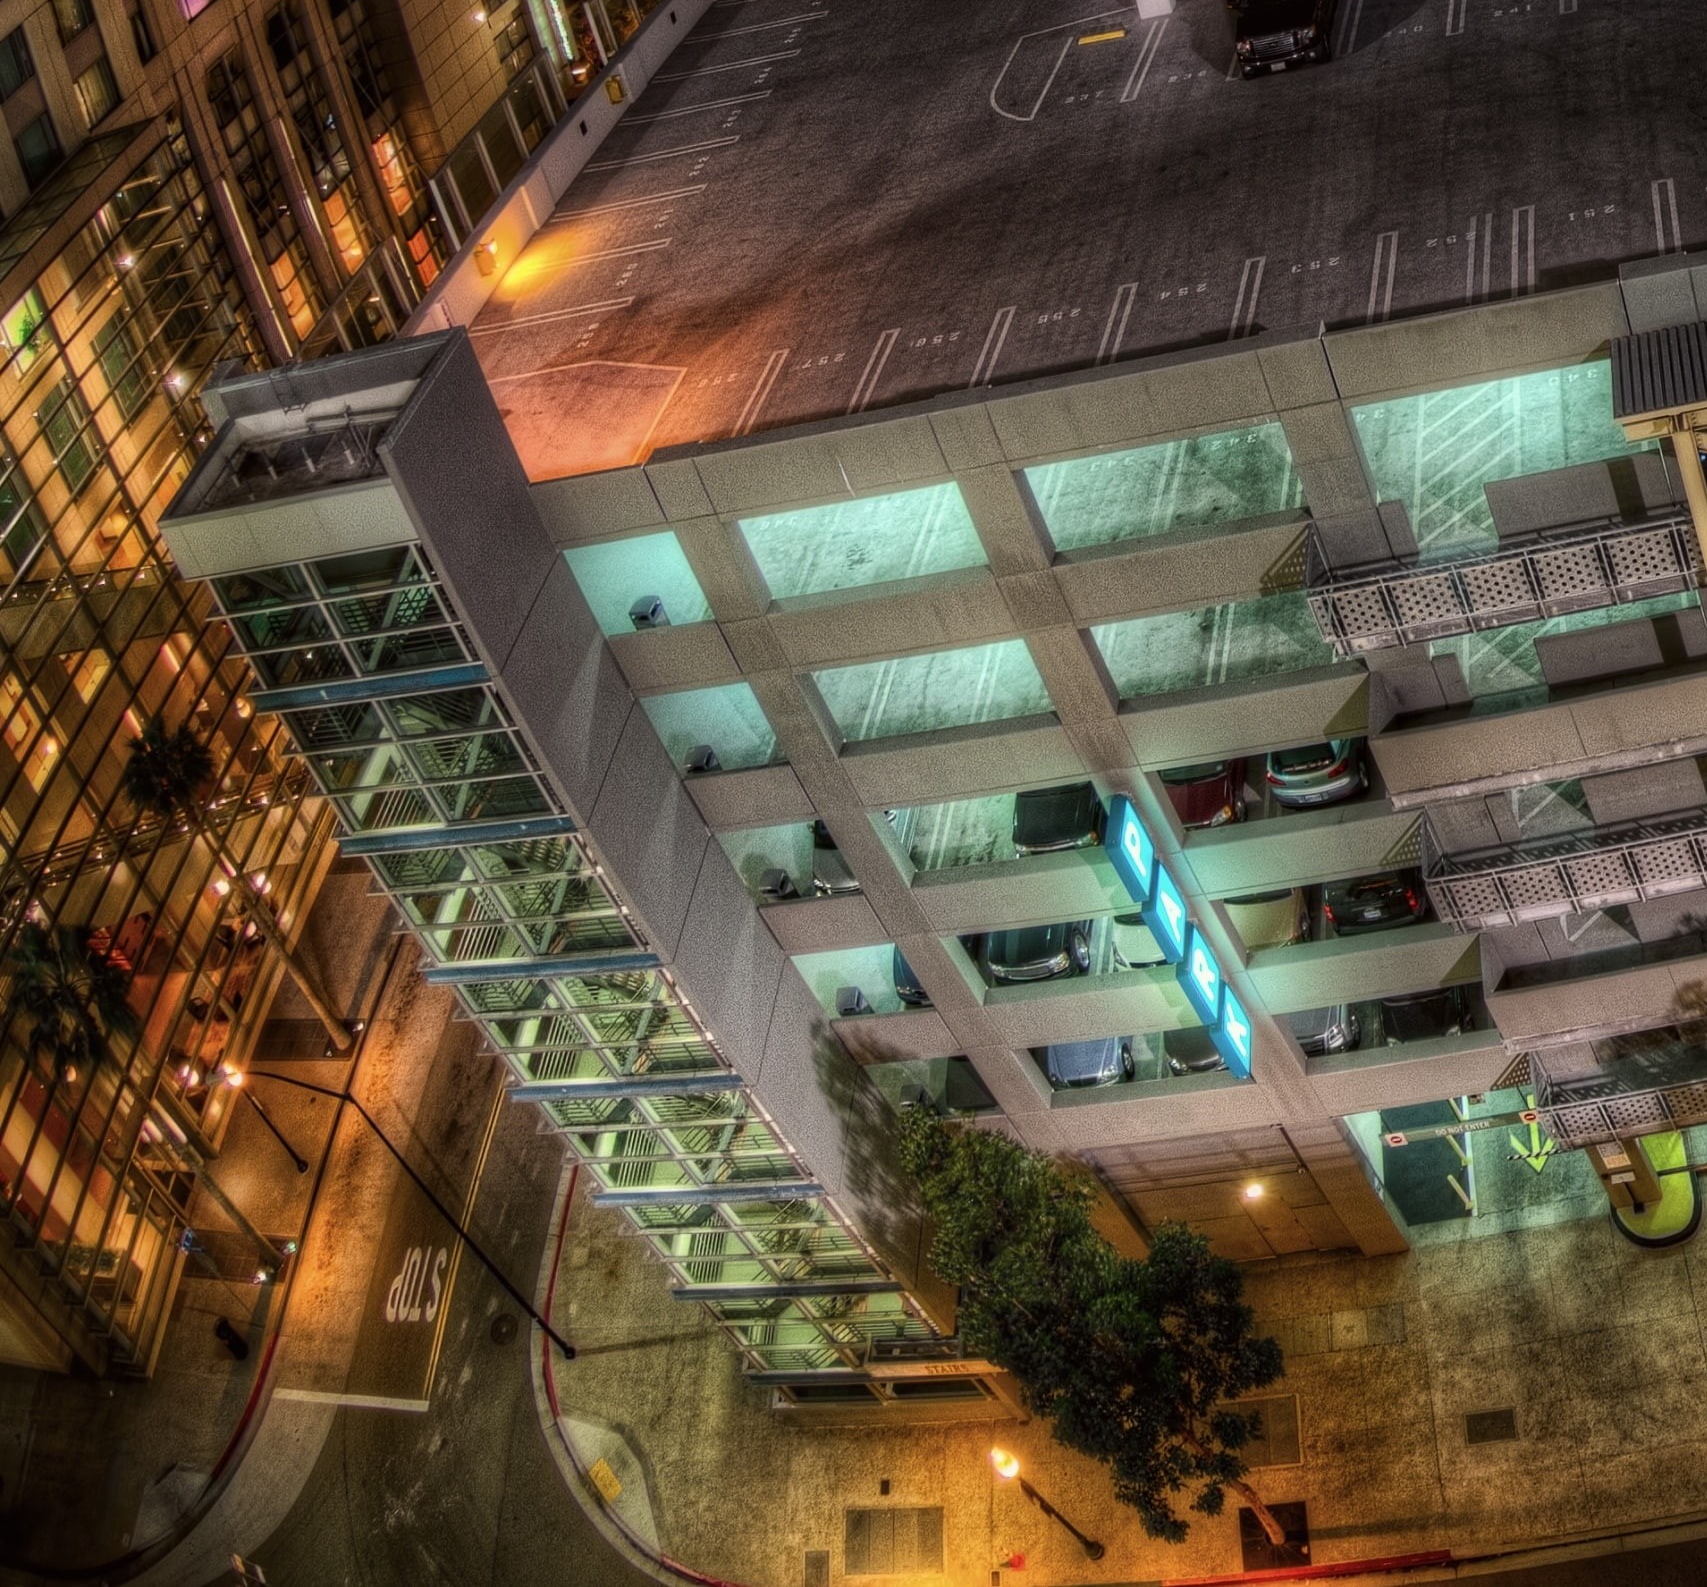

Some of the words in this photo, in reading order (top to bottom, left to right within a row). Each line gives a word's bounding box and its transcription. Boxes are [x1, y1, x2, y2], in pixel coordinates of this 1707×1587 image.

[1569, 205, 1615, 221] 251
[1291, 257, 1340, 274] 253
[1159, 283, 1206, 300] 254
[1124, 821, 1249, 1057] PARK
[1435, 1127, 1446, 1137] DO
[1448, 1124, 1463, 1135] NOT
[1465, 1120, 1491, 1132] ENTER
[386, 1245, 448, 1323] STOP
